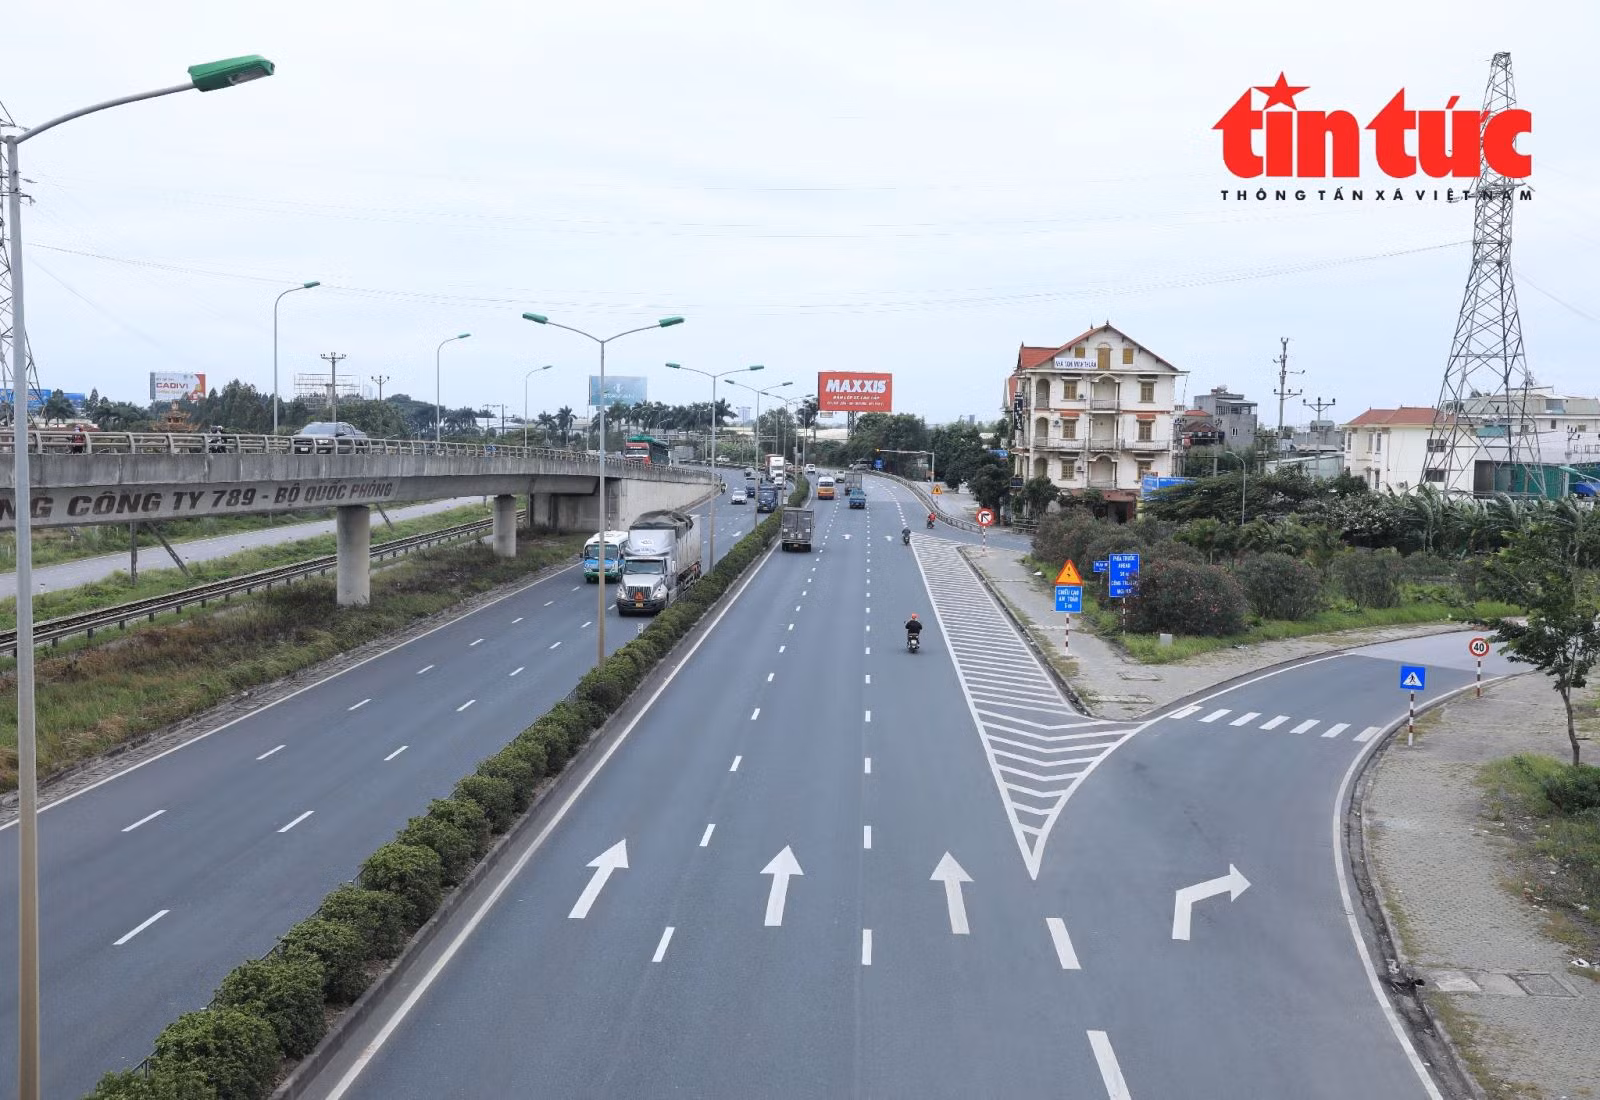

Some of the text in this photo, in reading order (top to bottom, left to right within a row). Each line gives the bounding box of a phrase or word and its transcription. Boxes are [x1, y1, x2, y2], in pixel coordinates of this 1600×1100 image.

[825, 379, 886, 393] MAXXIS
[67, 490, 162, 516] CÔNG
[172, 491, 205, 511] TY
[211, 488, 256, 508] 789
[274, 483, 300, 506] BỘ
[304, 480, 347, 503] QUỐC
[1473, 642, 1485, 652] 40
